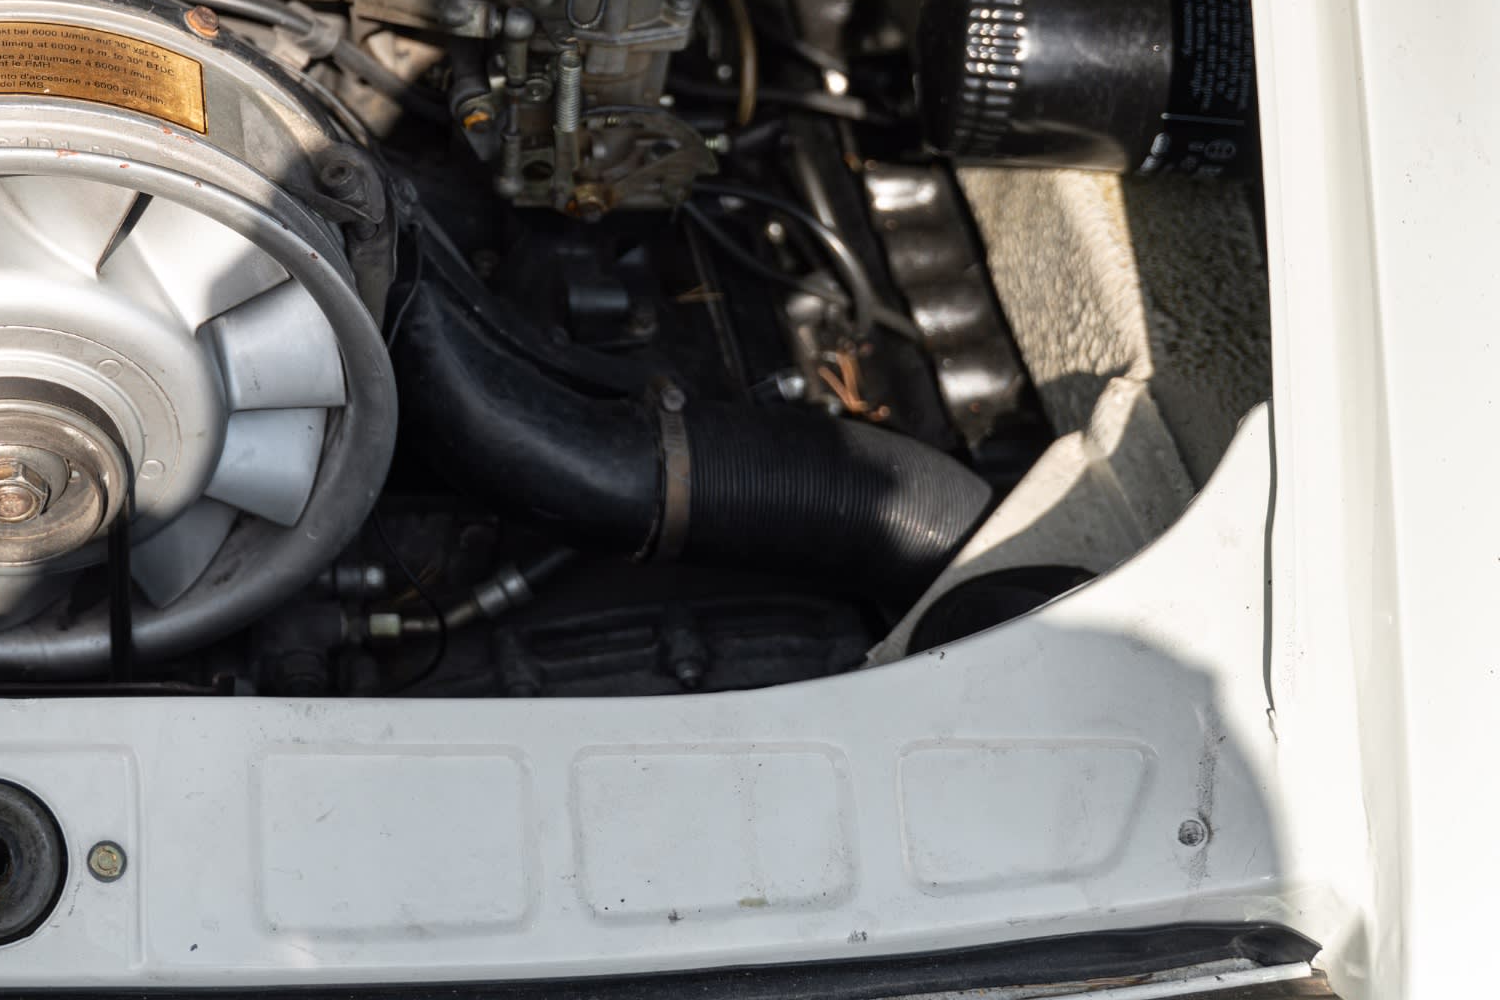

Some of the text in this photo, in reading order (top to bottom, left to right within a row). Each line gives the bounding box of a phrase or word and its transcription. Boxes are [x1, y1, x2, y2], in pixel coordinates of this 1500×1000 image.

[14, 28, 29, 36] bei
[32, 29, 58, 37] 6000
[1, 40, 33, 49] timing
[37, 41, 48, 49] at
[51, 43, 77, 52] 6000
[114, 53, 124, 61] to
[95, 61, 120, 72] 6000
[0, 80, 16, 88] del
[94, 81, 120, 92] 6000
